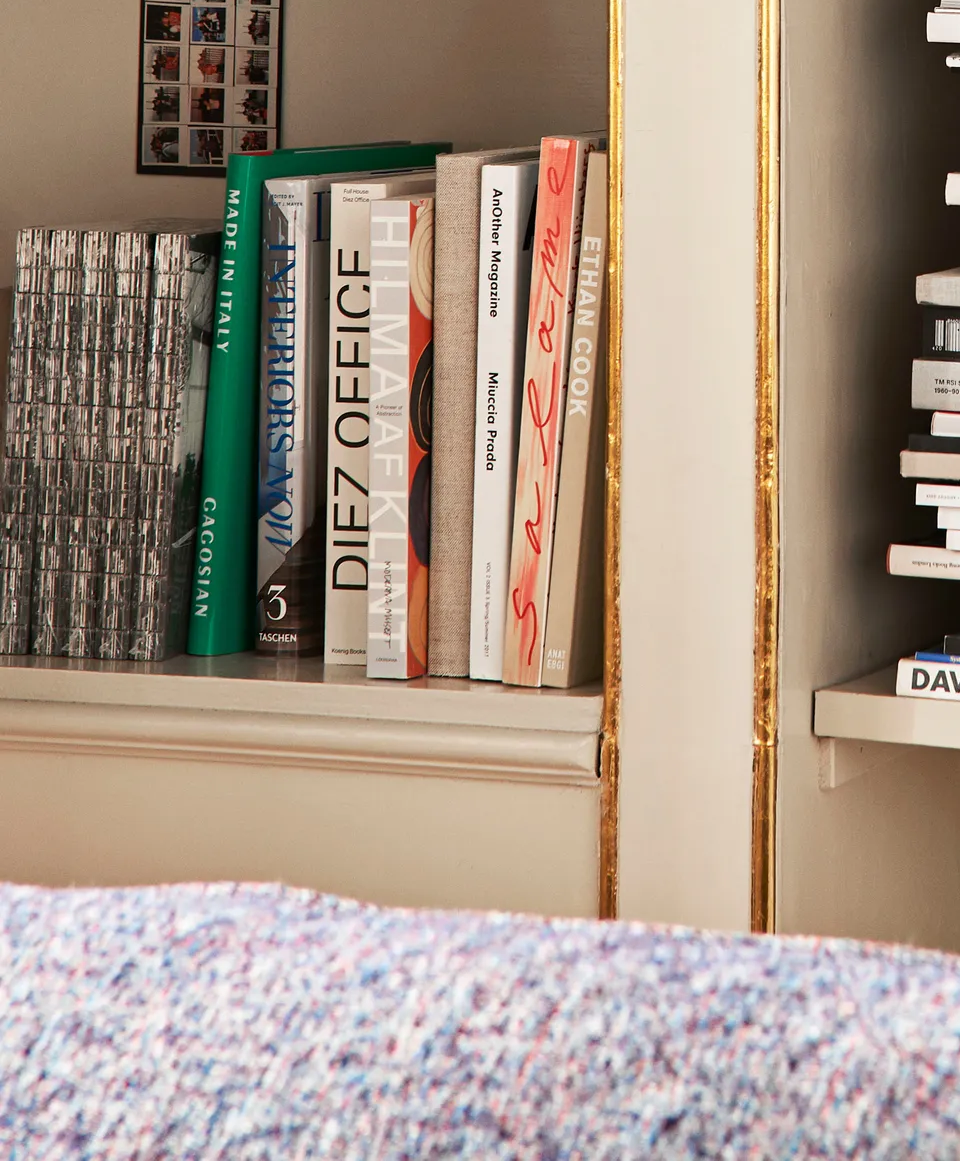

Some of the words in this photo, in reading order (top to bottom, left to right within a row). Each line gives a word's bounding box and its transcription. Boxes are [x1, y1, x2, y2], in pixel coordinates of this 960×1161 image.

[222, 189, 241, 251] MADE
[342, 196, 354, 204] Diez
[354, 196, 370, 204] Office
[353, 188, 370, 196] House
[488, 187, 504, 246] AnOther
[221, 258, 237, 282] IN
[485, 249, 503, 319] Magazine
[576, 235, 603, 327] ETHAN
[215, 290, 233, 355] ITALY
[369, 215, 408, 409] HILMA
[264, 241, 297, 454] INTERIORS
[333, 248, 369, 450] OFFICE
[568, 336, 594, 418] COOK
[486, 371, 500, 425] Miuccia
[373, 417, 404, 477] AF
[484, 429, 499, 472] Prada
[262, 465, 295, 558] NOW
[331, 465, 369, 591] DIEZ
[194, 496, 218, 618] GAGOSIAN
[369, 490, 408, 654] KLINT
[265, 584, 288, 621] 3
[258, 632, 298, 643] TASCHEN
[331, 648, 349, 657] Koenig
[349, 648, 367, 656] Books
[547, 648, 566, 659] ANAT
